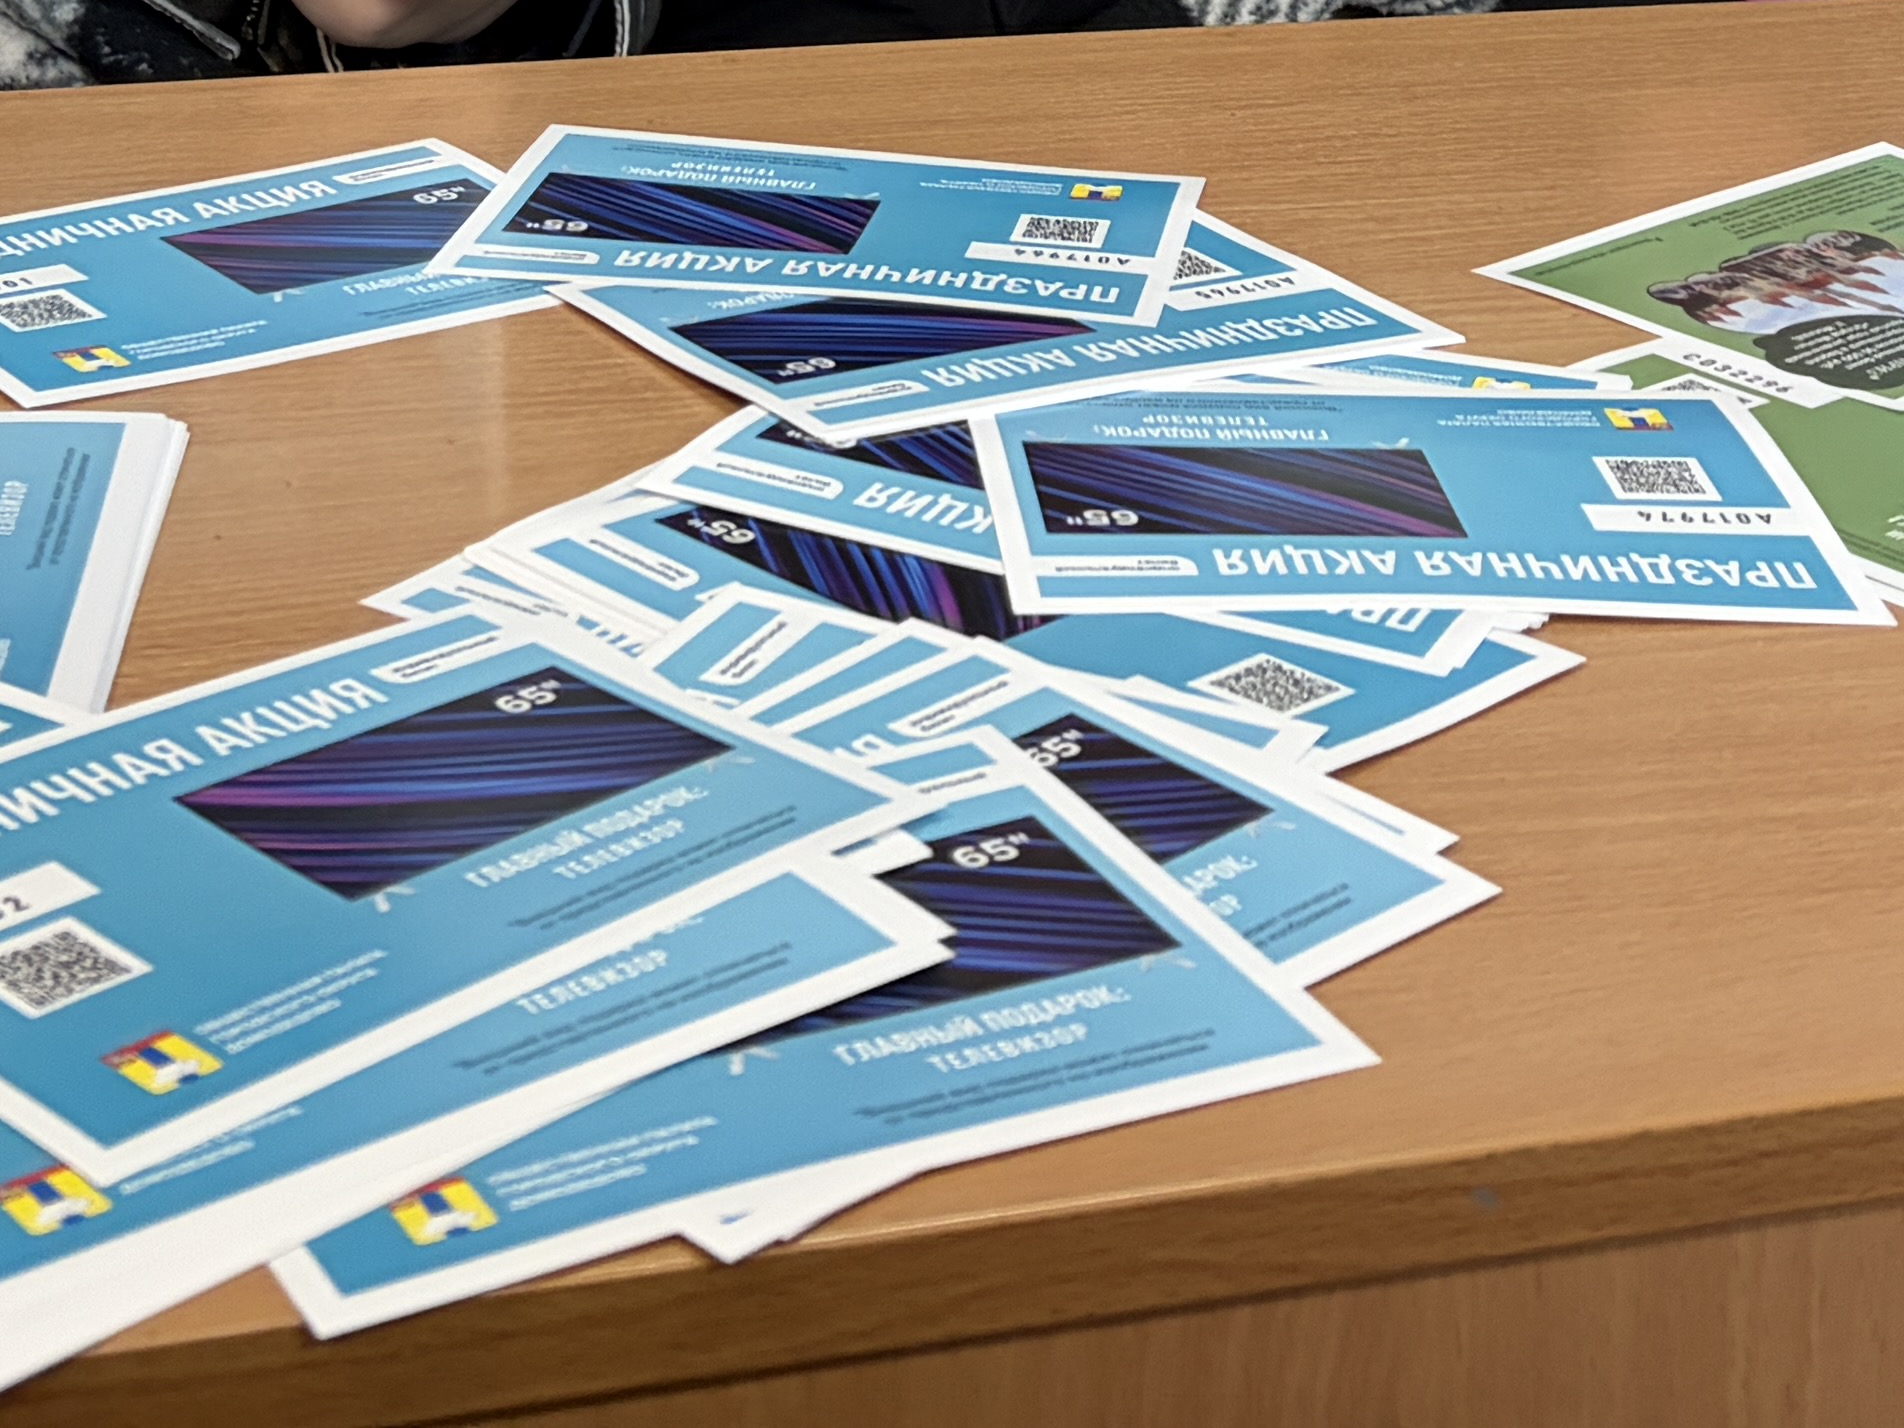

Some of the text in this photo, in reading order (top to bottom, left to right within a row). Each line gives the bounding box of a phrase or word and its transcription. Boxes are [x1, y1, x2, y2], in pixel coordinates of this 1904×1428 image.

[191, 179, 338, 223] АКЦИЯ
[612, 247, 1121, 305] ПРАЗДНИЧНАЯ АКЦИЯ
[1213, 545, 1820, 592] ПРАЗДНИЧНАЯ АКЦИЯ
[210, 677, 392, 759] АКЦИЯ
[462, 782, 710, 889] ГЛАВНЫЙ ПОДАРОК:
[550, 819, 687, 881] ТЕЛЕВИЗОР
